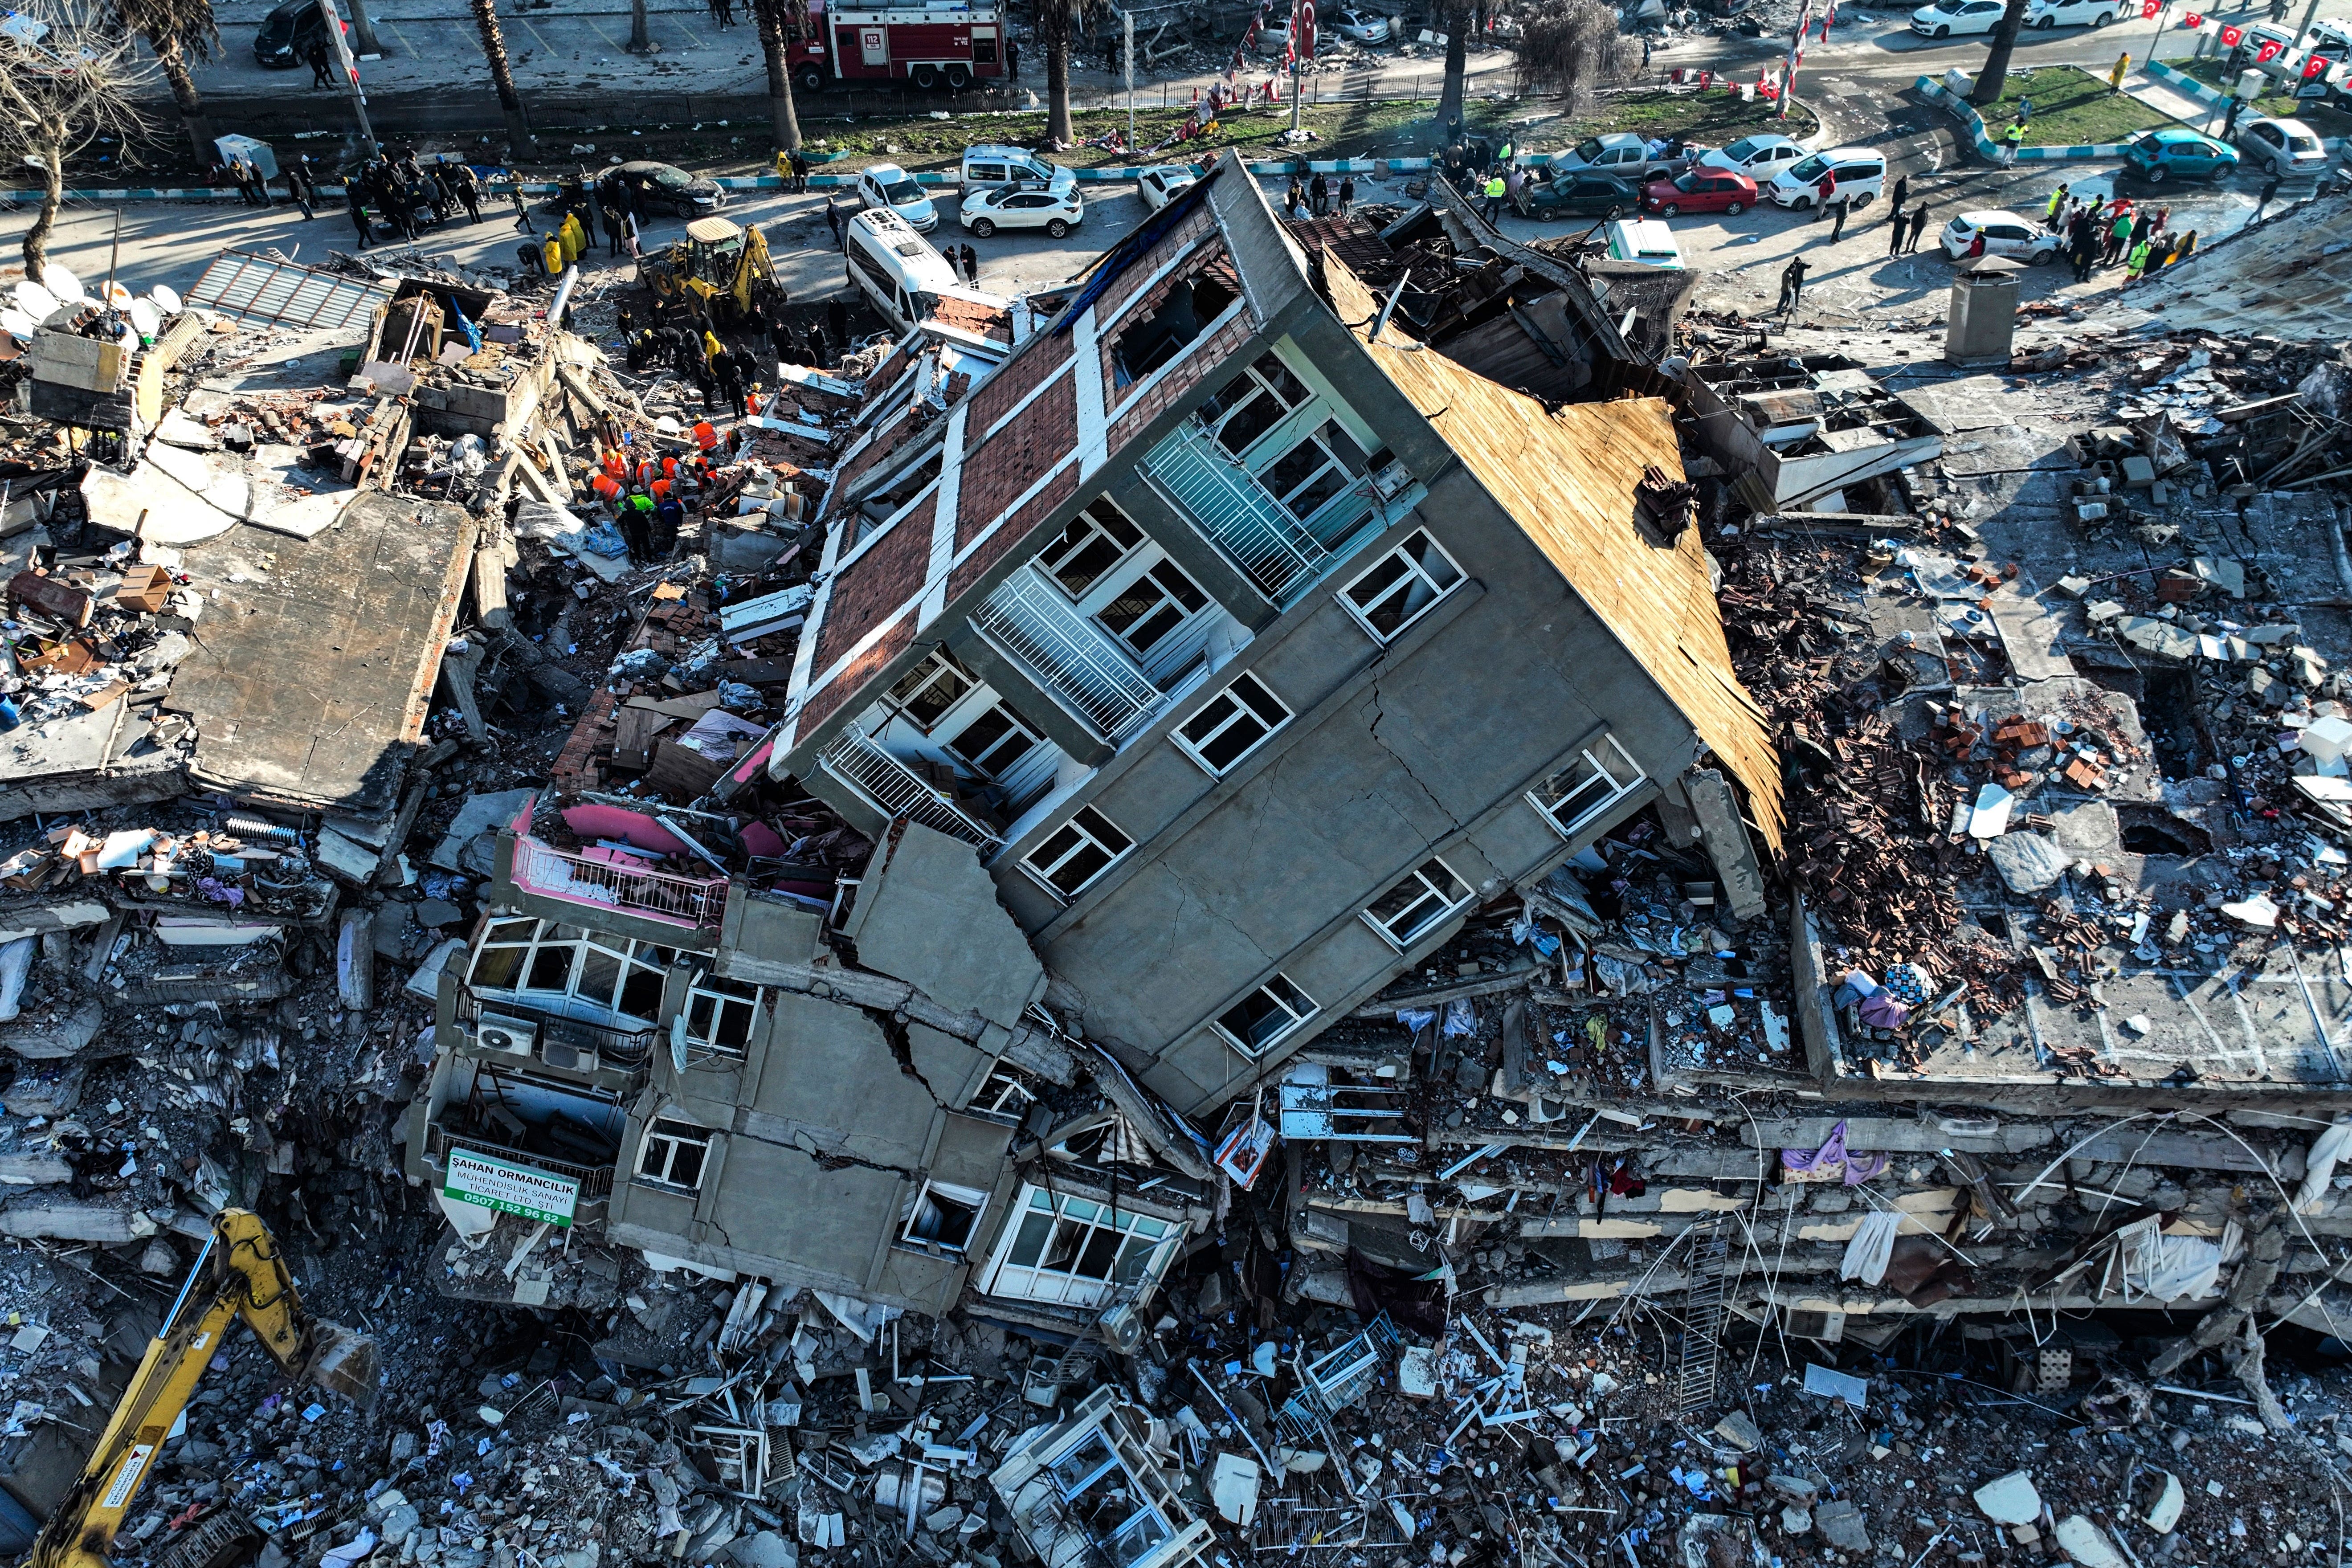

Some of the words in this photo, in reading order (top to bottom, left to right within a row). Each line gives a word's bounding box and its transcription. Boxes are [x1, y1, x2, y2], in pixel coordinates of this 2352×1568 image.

[867, 36, 878, 44] 112
[452, 1158, 493, 1175] ŞAHAN
[498, 1169, 574, 1195] ORMANCILIK
[457, 1172, 528, 1194] MÜHENDİSLİK
[532, 1190, 567, 1204] SANAYİ
[464, 1193, 495, 1206] 0507
[498, 1201, 521, 1214] 152
[524, 1209, 539, 1218] 96
[543, 1213, 559, 1224] 62
[469, 1183, 511, 1199] TİCARET
[514, 1195, 534, 1206] LTD.
[538, 1201, 553, 1210] ŞTİ
